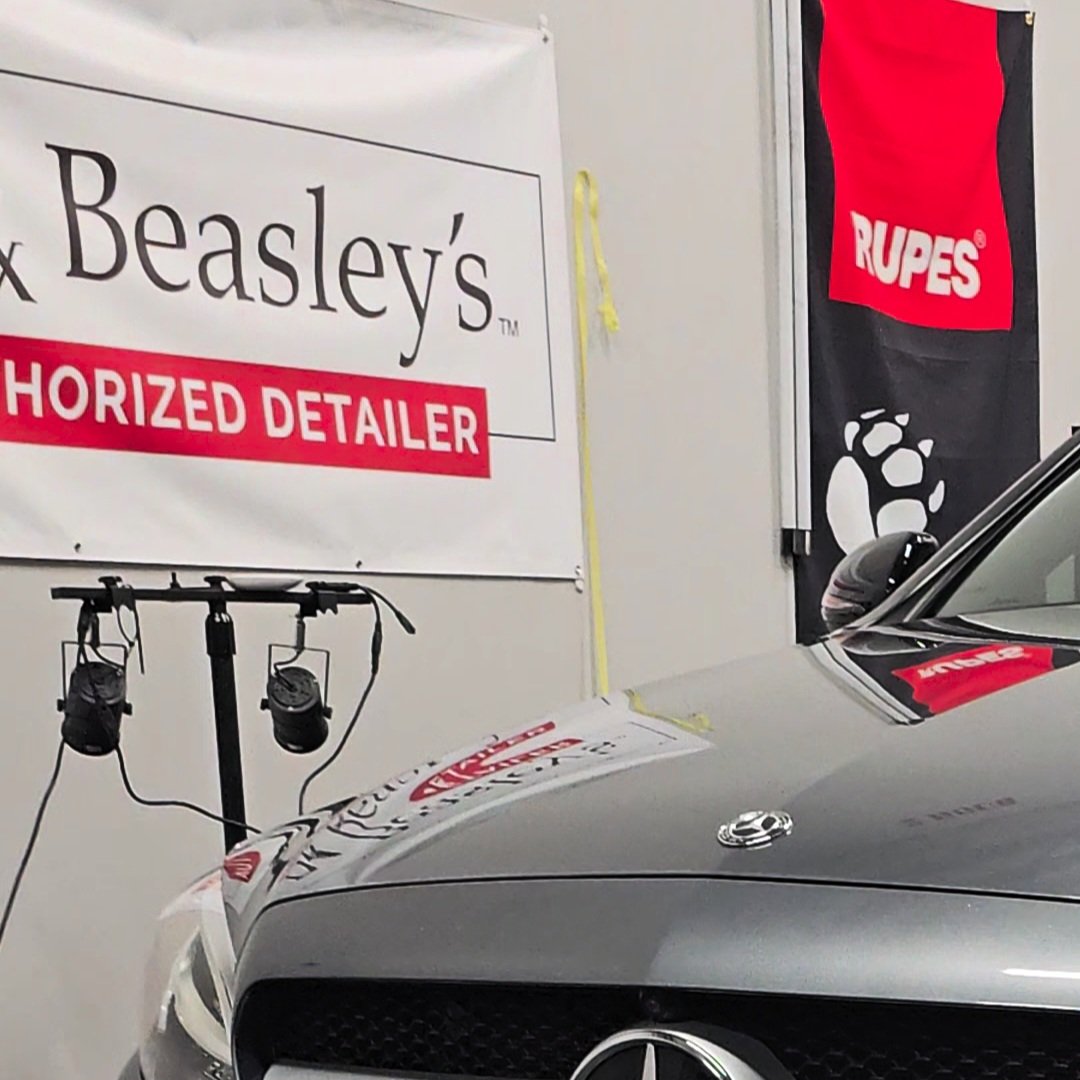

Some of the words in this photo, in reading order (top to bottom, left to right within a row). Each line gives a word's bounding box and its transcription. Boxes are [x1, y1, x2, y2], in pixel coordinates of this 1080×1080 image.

[44, 143, 492, 368] Beasley's
[4, 358, 246, 434] HORIZED
[262, 387, 479, 454] DETAILER
